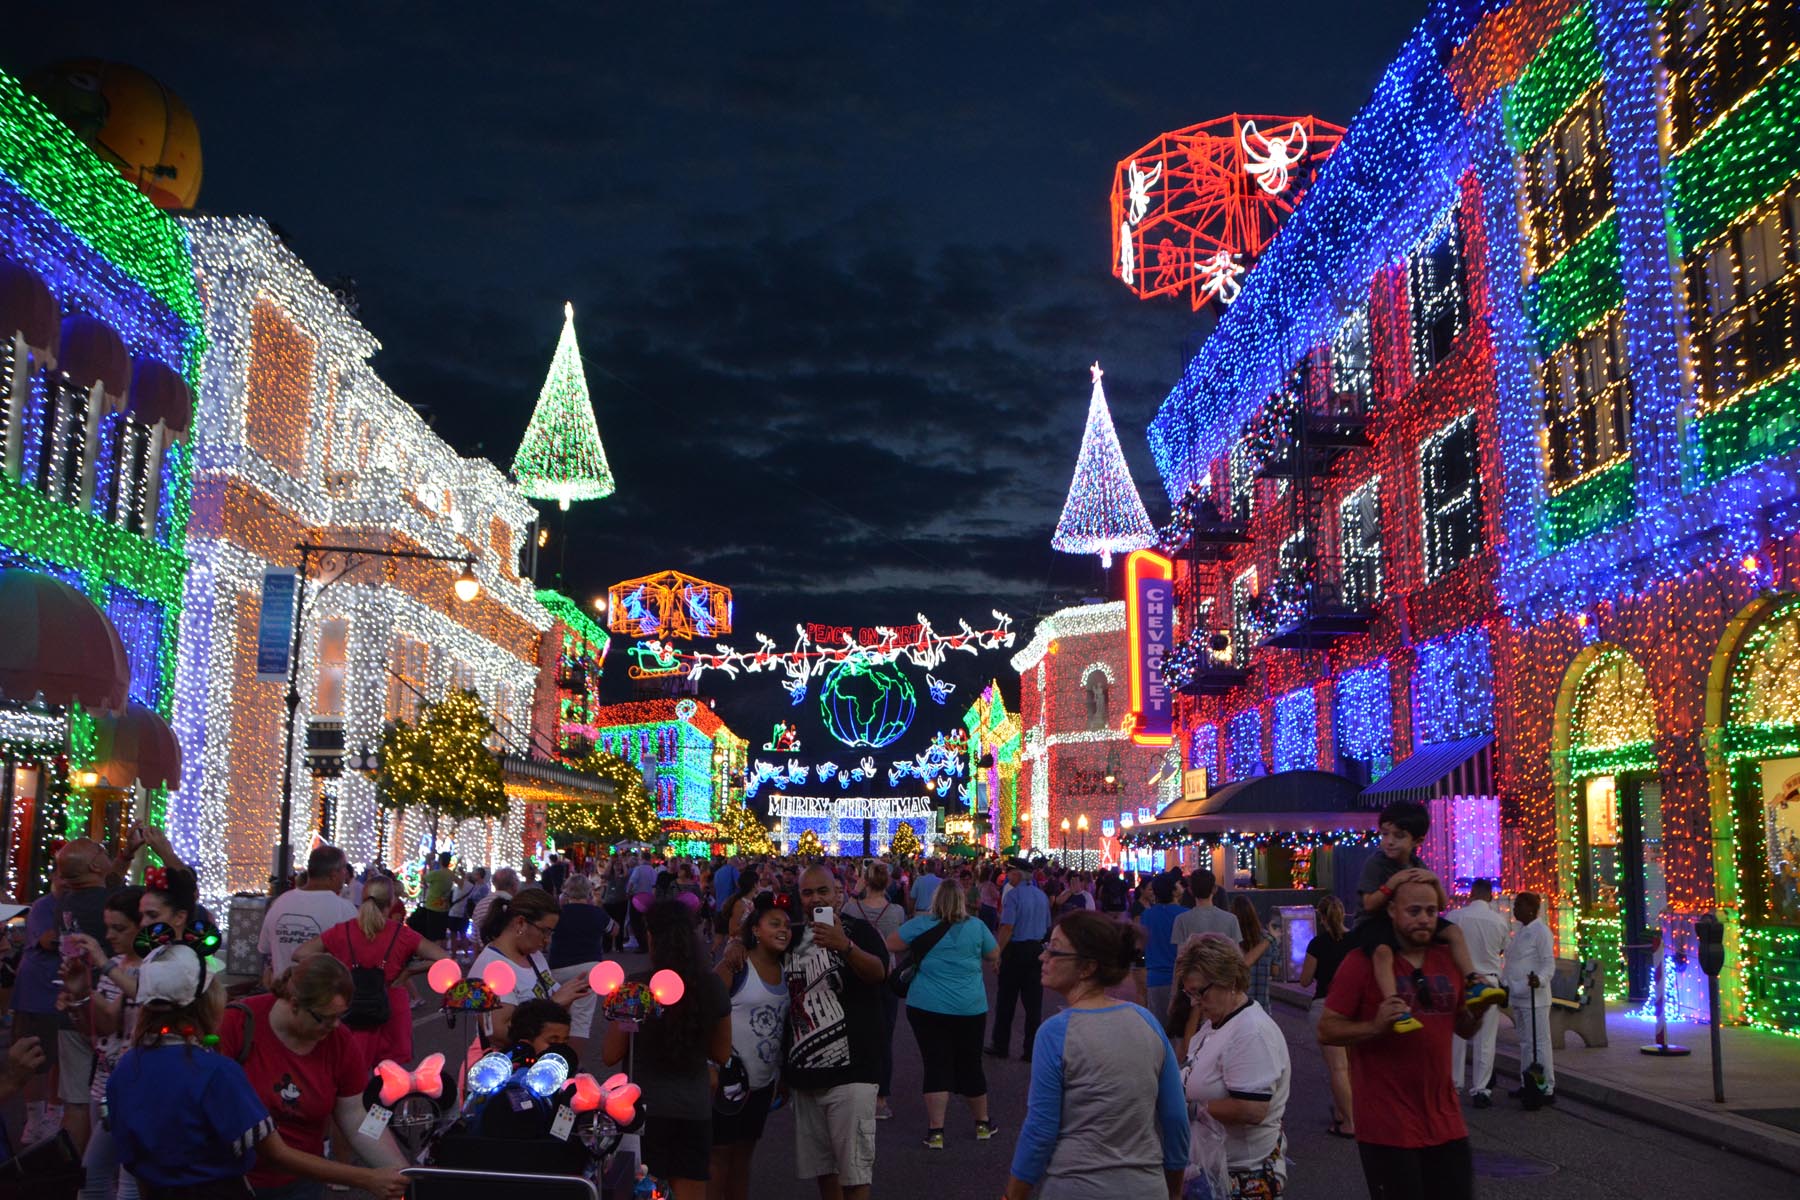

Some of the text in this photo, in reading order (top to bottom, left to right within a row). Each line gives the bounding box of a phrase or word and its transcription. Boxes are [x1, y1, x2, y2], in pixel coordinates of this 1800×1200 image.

[806, 622, 853, 645] PEACE
[859, 627, 879, 645] ON
[1146, 588, 1166, 711] CHEVROLET
[768, 794, 931, 819] MERRY CHRISTMAS
